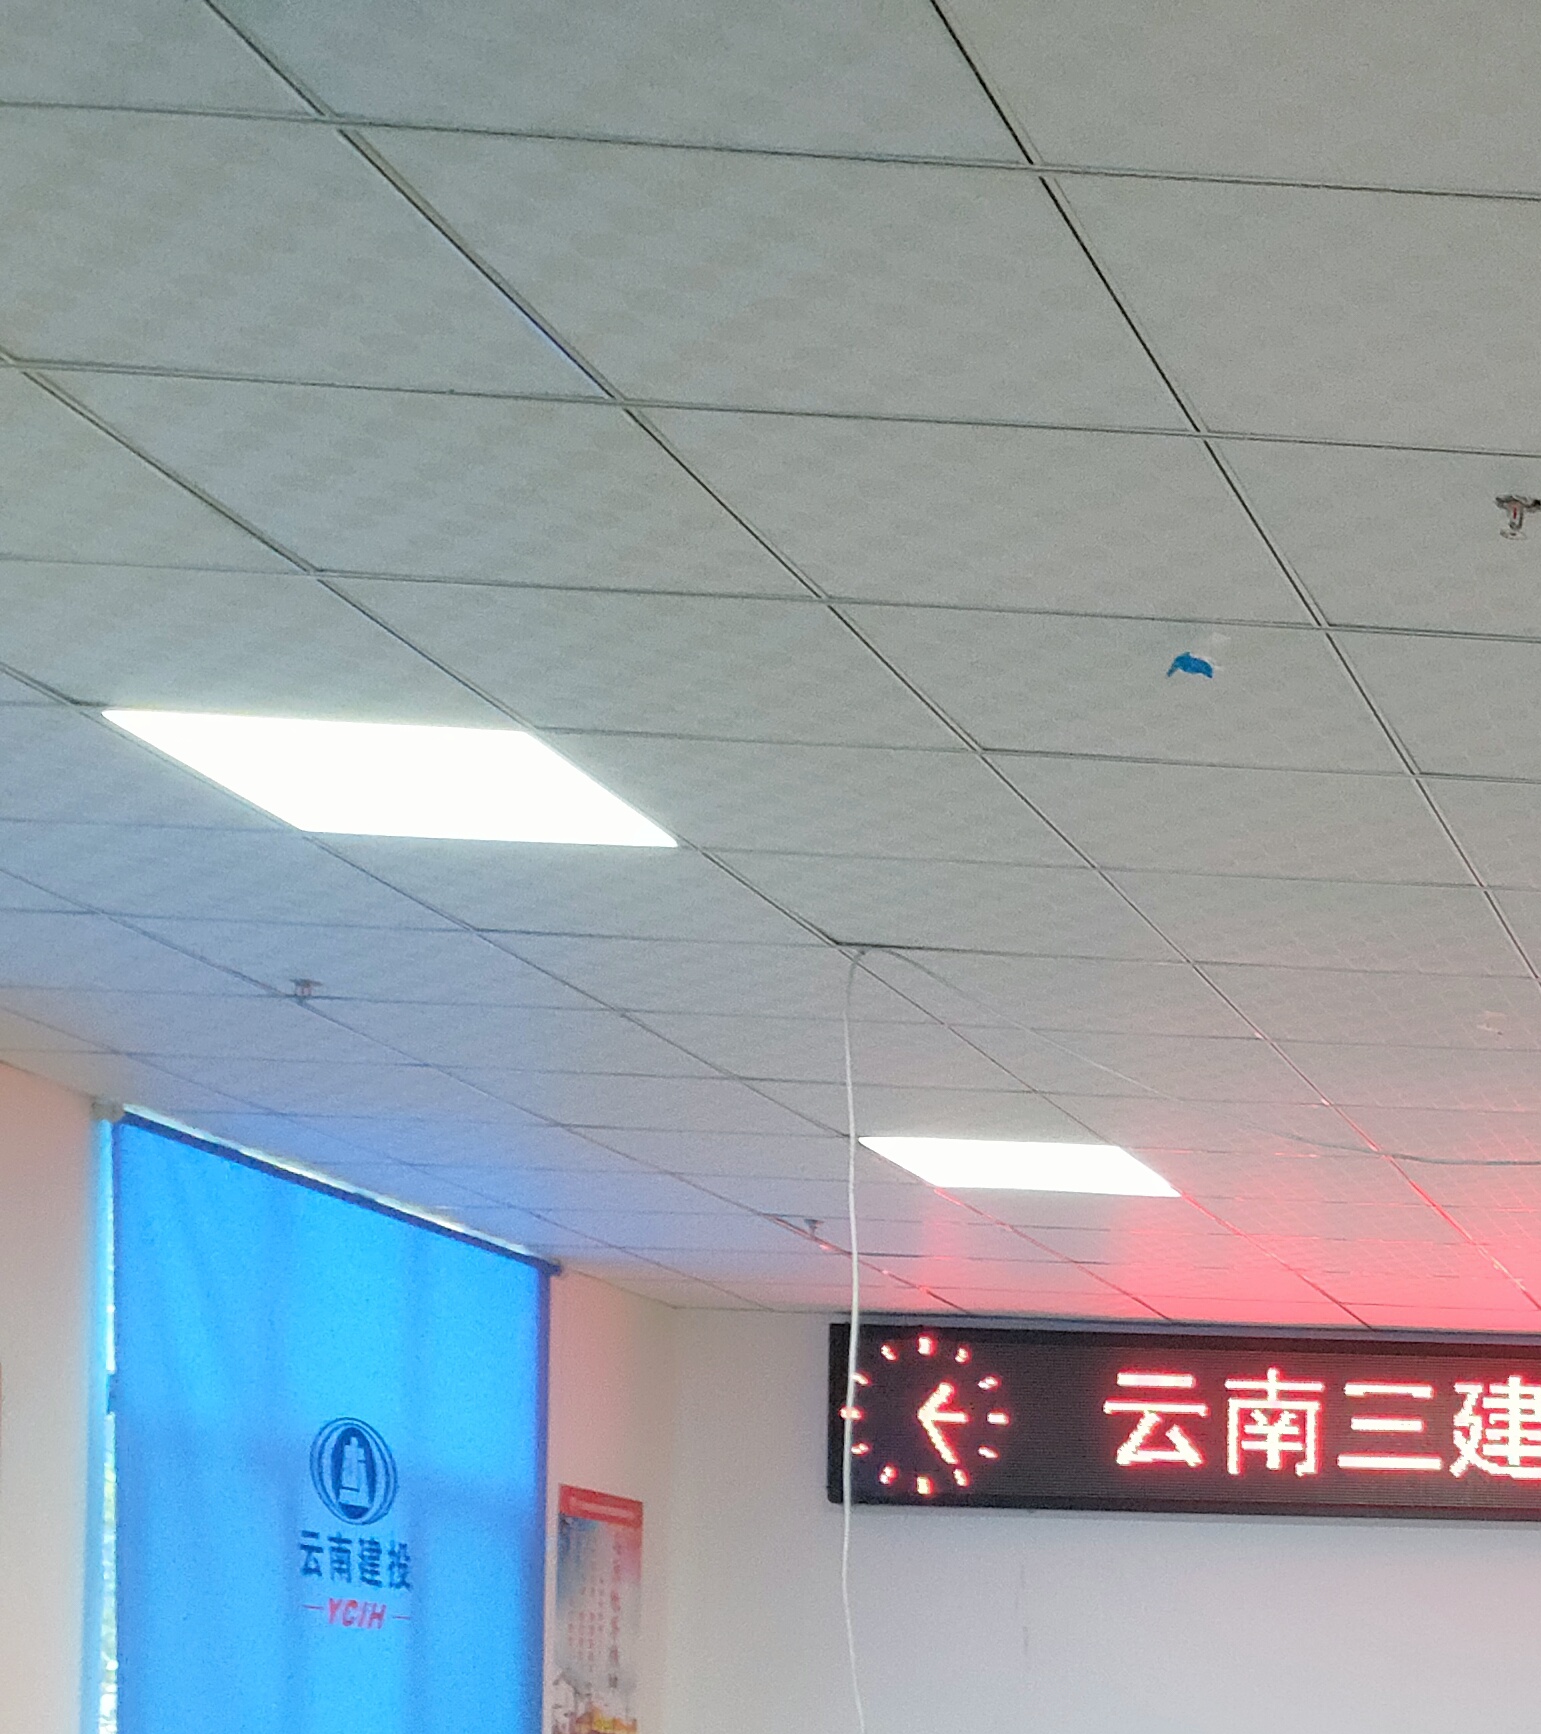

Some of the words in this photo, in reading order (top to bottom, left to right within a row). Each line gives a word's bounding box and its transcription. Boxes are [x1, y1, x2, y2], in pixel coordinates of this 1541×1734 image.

[299, 1530, 413, 1590] 云南建投
[328, 1597, 387, 1629] YCIH
